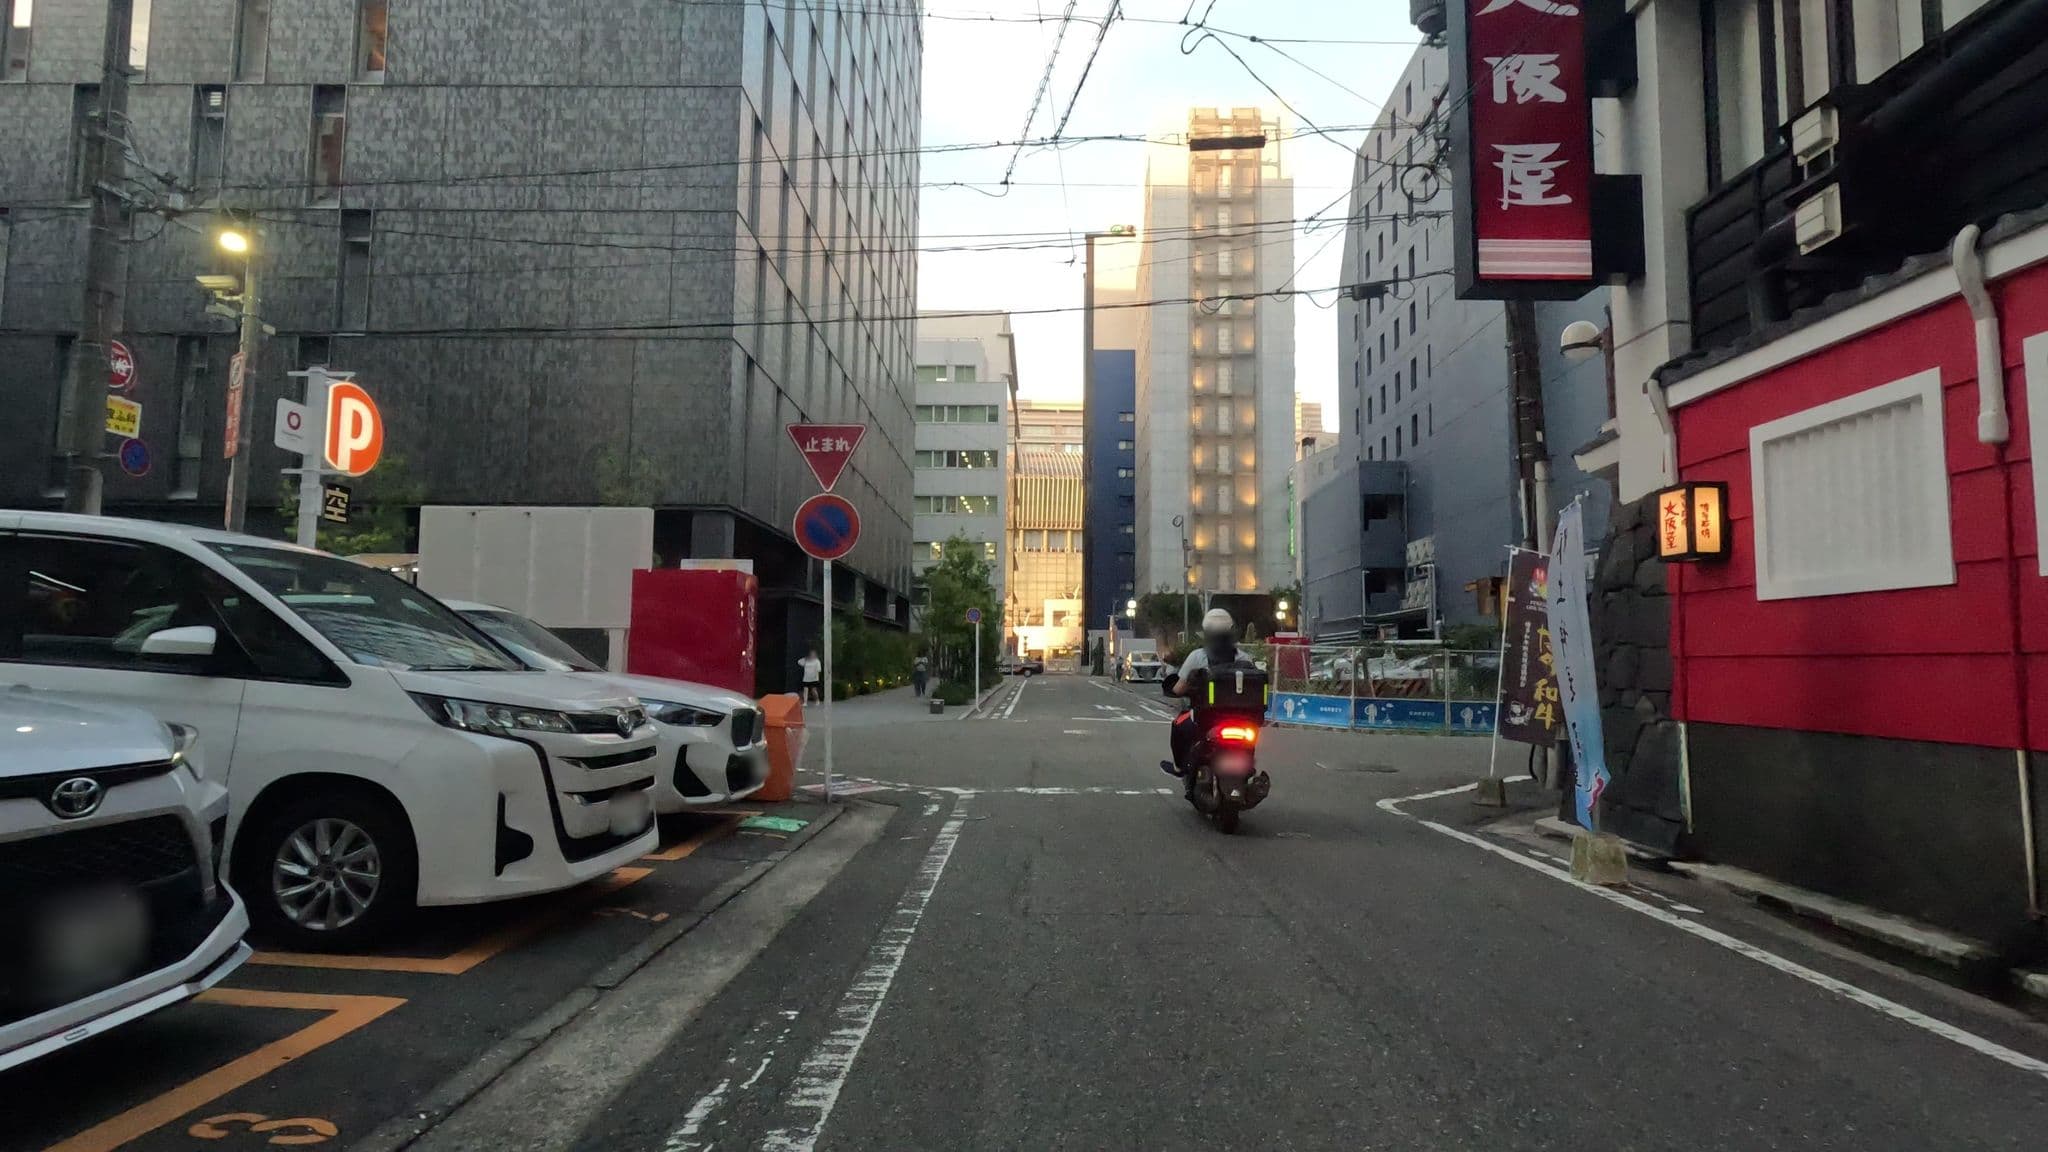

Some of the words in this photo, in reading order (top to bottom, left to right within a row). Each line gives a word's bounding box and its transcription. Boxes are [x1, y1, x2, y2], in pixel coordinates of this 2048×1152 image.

[1474, 0, 1581, 211] 阪屋
[337, 397, 374, 471] P
[804, 436, 851, 453] 止まれ
[324, 487, 349, 523] 空
